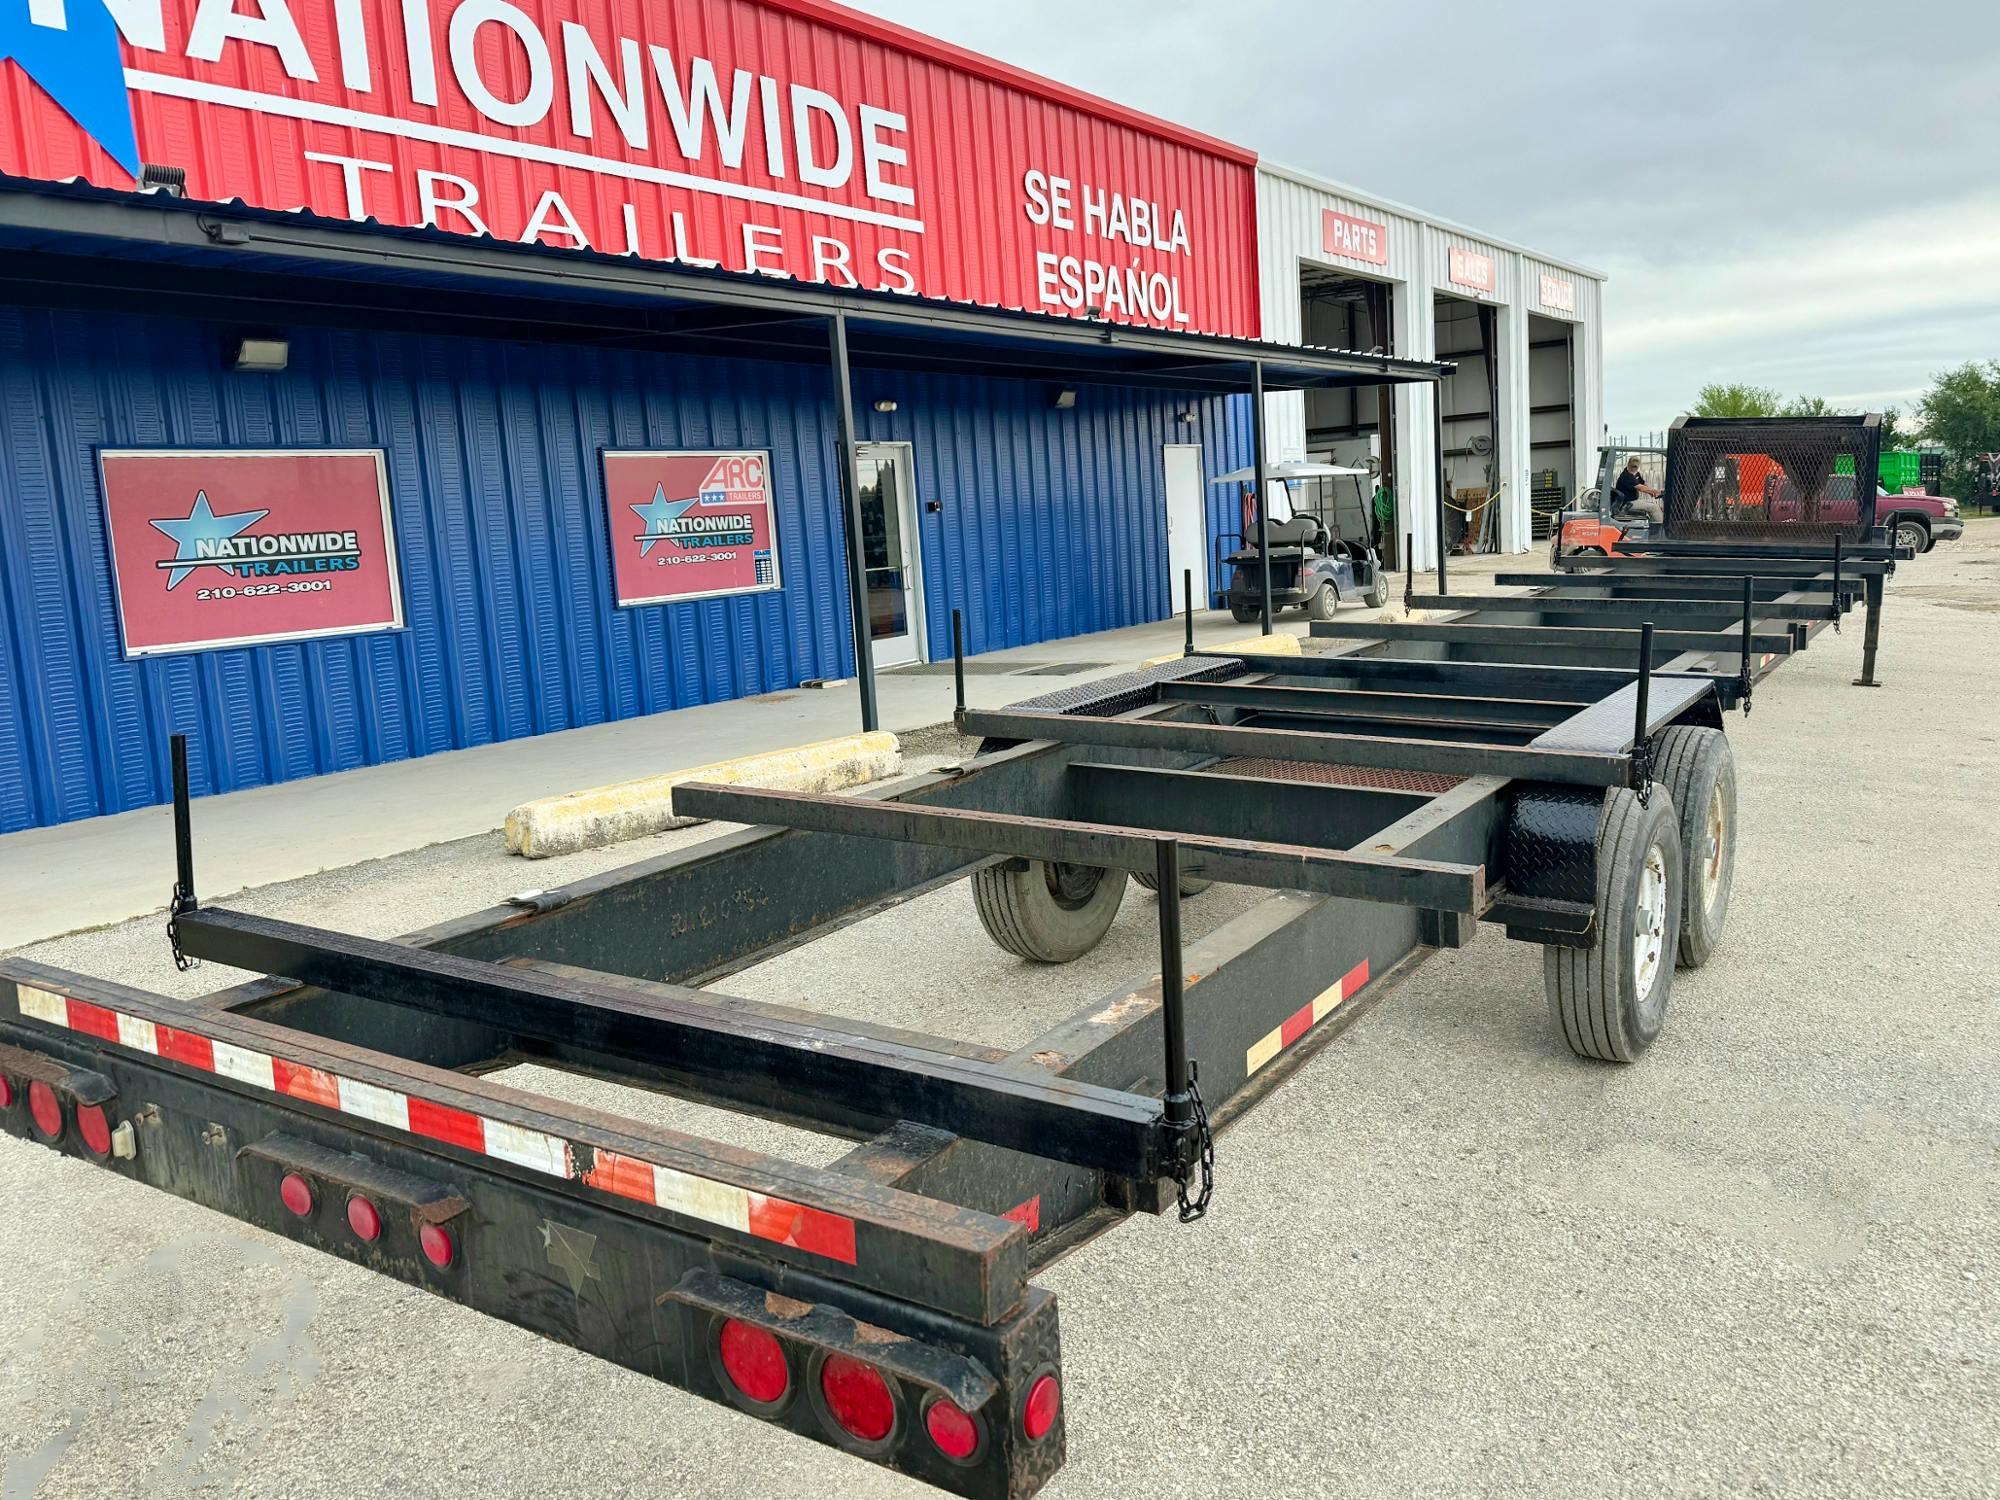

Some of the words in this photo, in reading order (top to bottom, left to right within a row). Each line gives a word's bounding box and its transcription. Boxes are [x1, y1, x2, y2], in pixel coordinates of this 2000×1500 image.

[1024, 169, 1074, 231] SE
[1083, 184, 1192, 256] HABLA
[304, 151, 916, 296] TRAILERS
[1333, 218, 1377, 257] PARTS
[702, 457, 764, 489] ARC
[728, 491, 762, 501] TRAILERS
[656, 514, 752, 534] NATIONWIDE
[196, 532, 357, 557] NATIONWIDE
[680, 534, 752, 547] TRAILERS
[237, 558, 359, 577] TRAILERS
[657, 552, 737, 565] 210-622-3001
[196, 580, 332, 600] 210-622-3001
